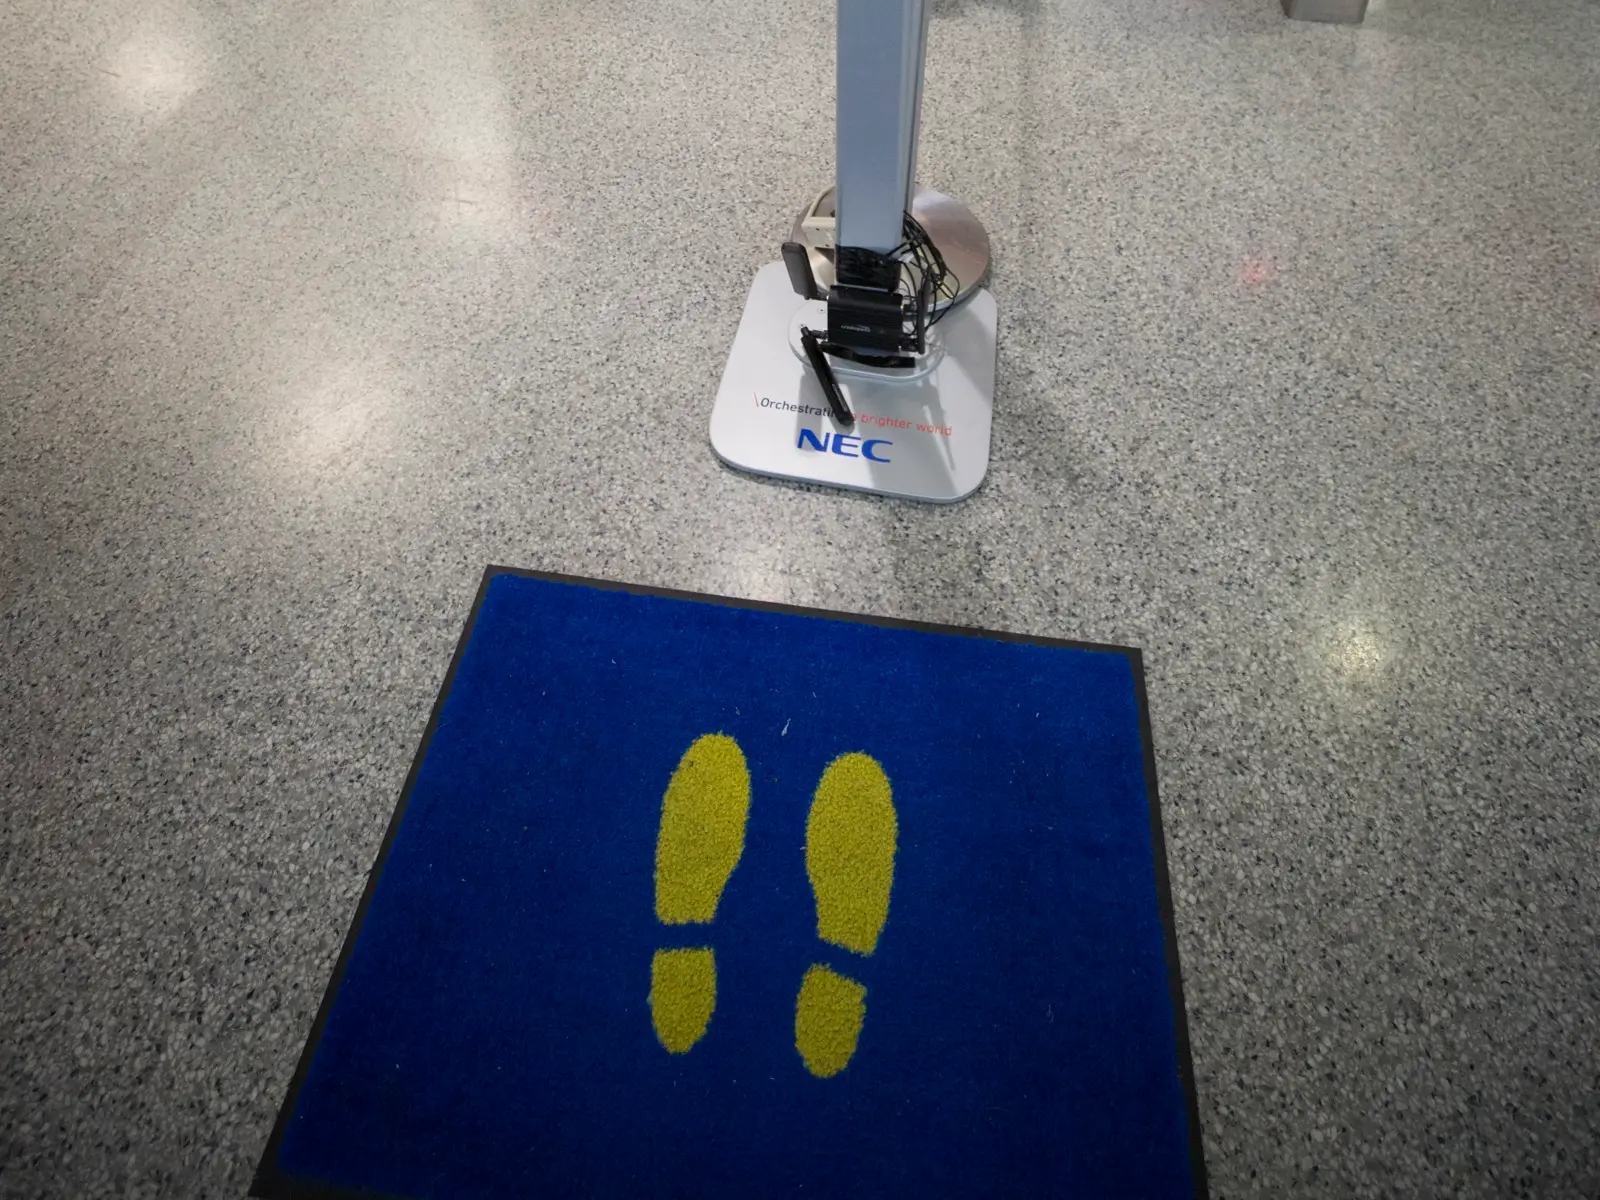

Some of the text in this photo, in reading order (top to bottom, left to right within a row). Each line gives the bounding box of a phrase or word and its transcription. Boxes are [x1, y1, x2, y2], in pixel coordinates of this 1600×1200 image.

[861, 412, 912, 429] brighter
[916, 422, 953, 437] world
[796, 427, 893, 464] NEC
